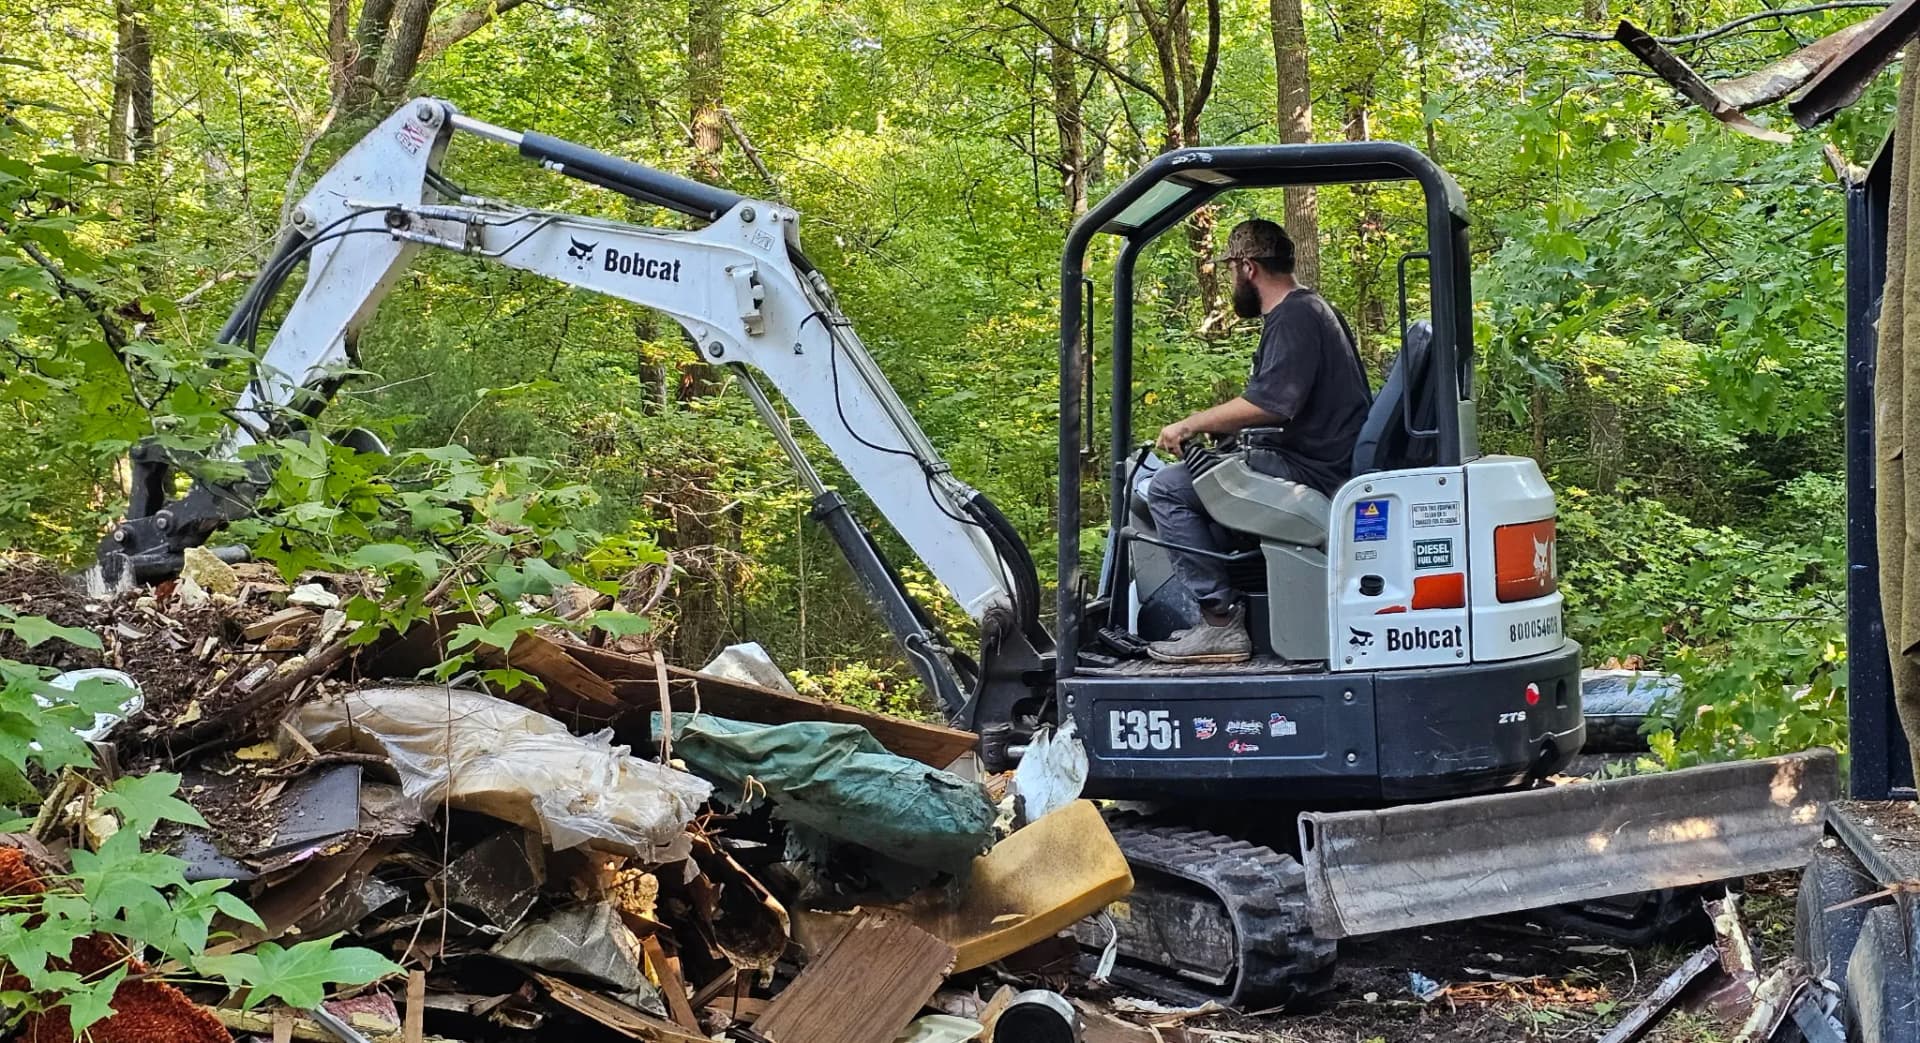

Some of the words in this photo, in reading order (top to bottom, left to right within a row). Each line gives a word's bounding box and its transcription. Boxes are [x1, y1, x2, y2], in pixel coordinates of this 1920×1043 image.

[604, 248, 681, 282] Bobcat
[1417, 543, 1449, 555] DIESEL
[1418, 556, 1432, 565] FUEL
[1433, 555, 1449, 563] ONLY
[1387, 625, 1462, 651] Bobcat
[1498, 711, 1526, 724] ZTS
[1110, 710, 1181, 750] E35i
